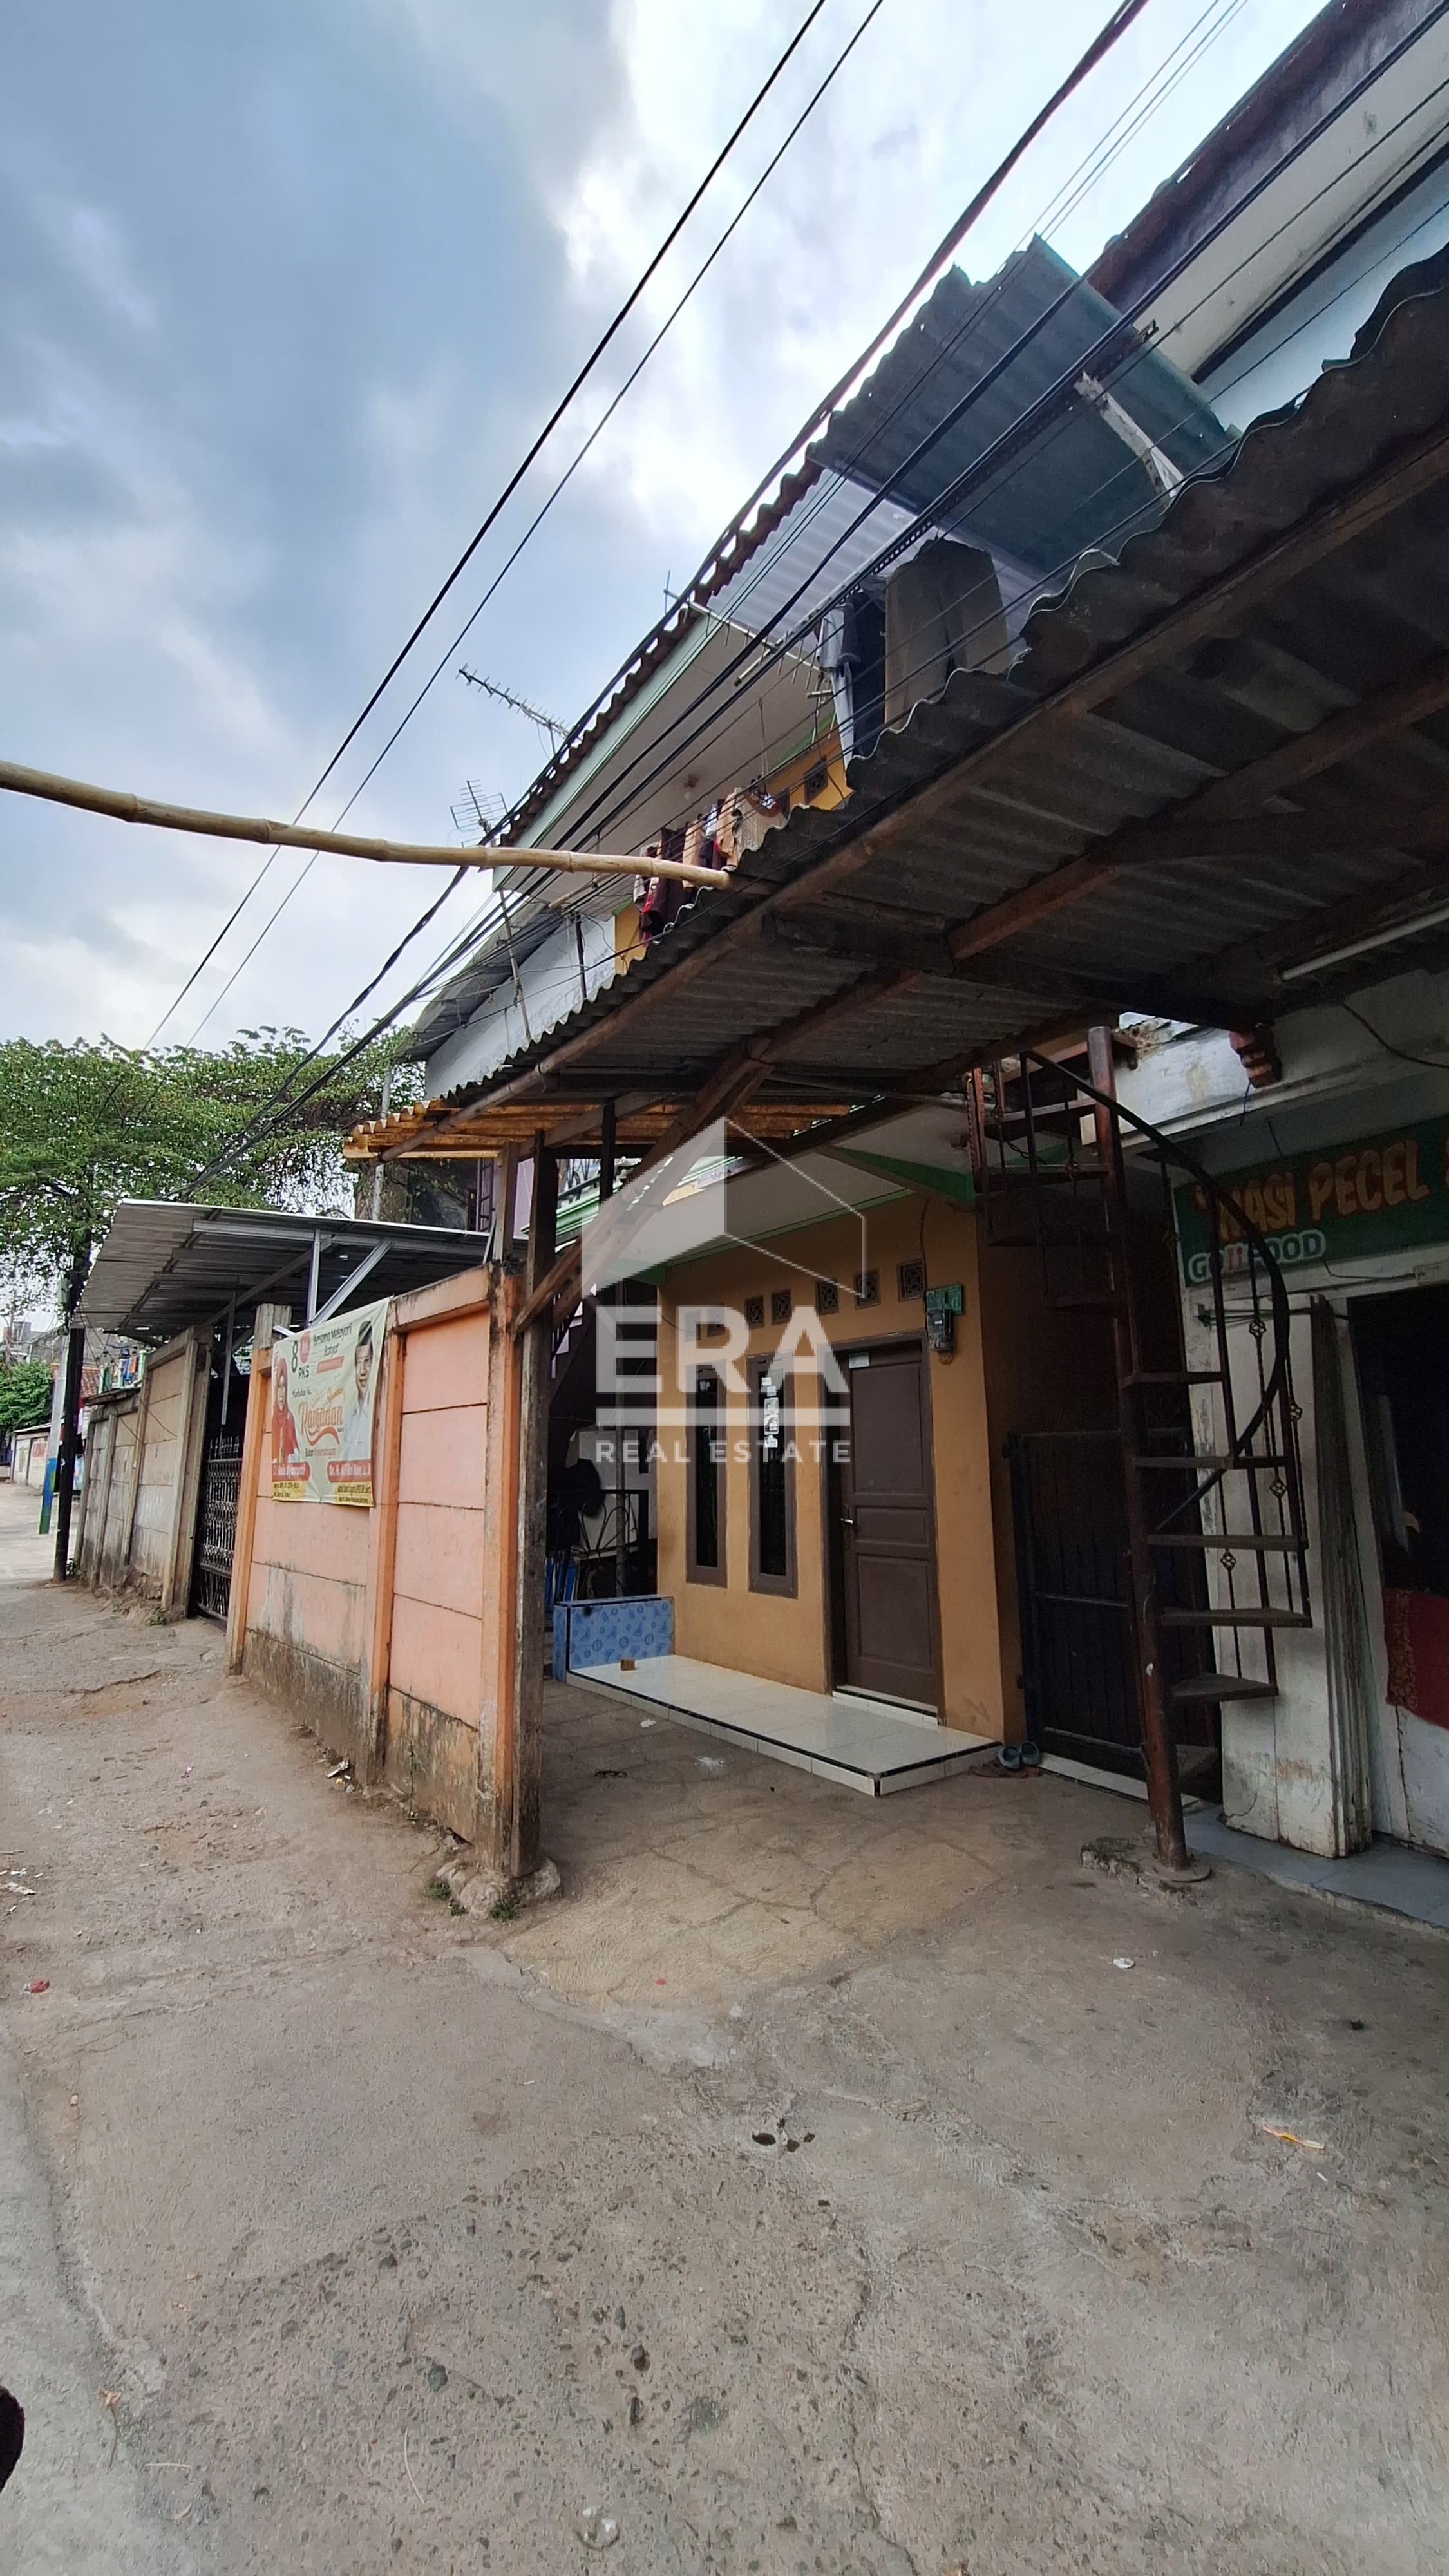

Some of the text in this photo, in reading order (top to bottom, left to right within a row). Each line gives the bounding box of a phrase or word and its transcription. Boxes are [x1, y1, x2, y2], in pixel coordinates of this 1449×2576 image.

[1307, 1139, 1431, 1222] PECEL
[291, 1340, 298, 1373] 8
[298, 1365, 310, 1380] PKS
